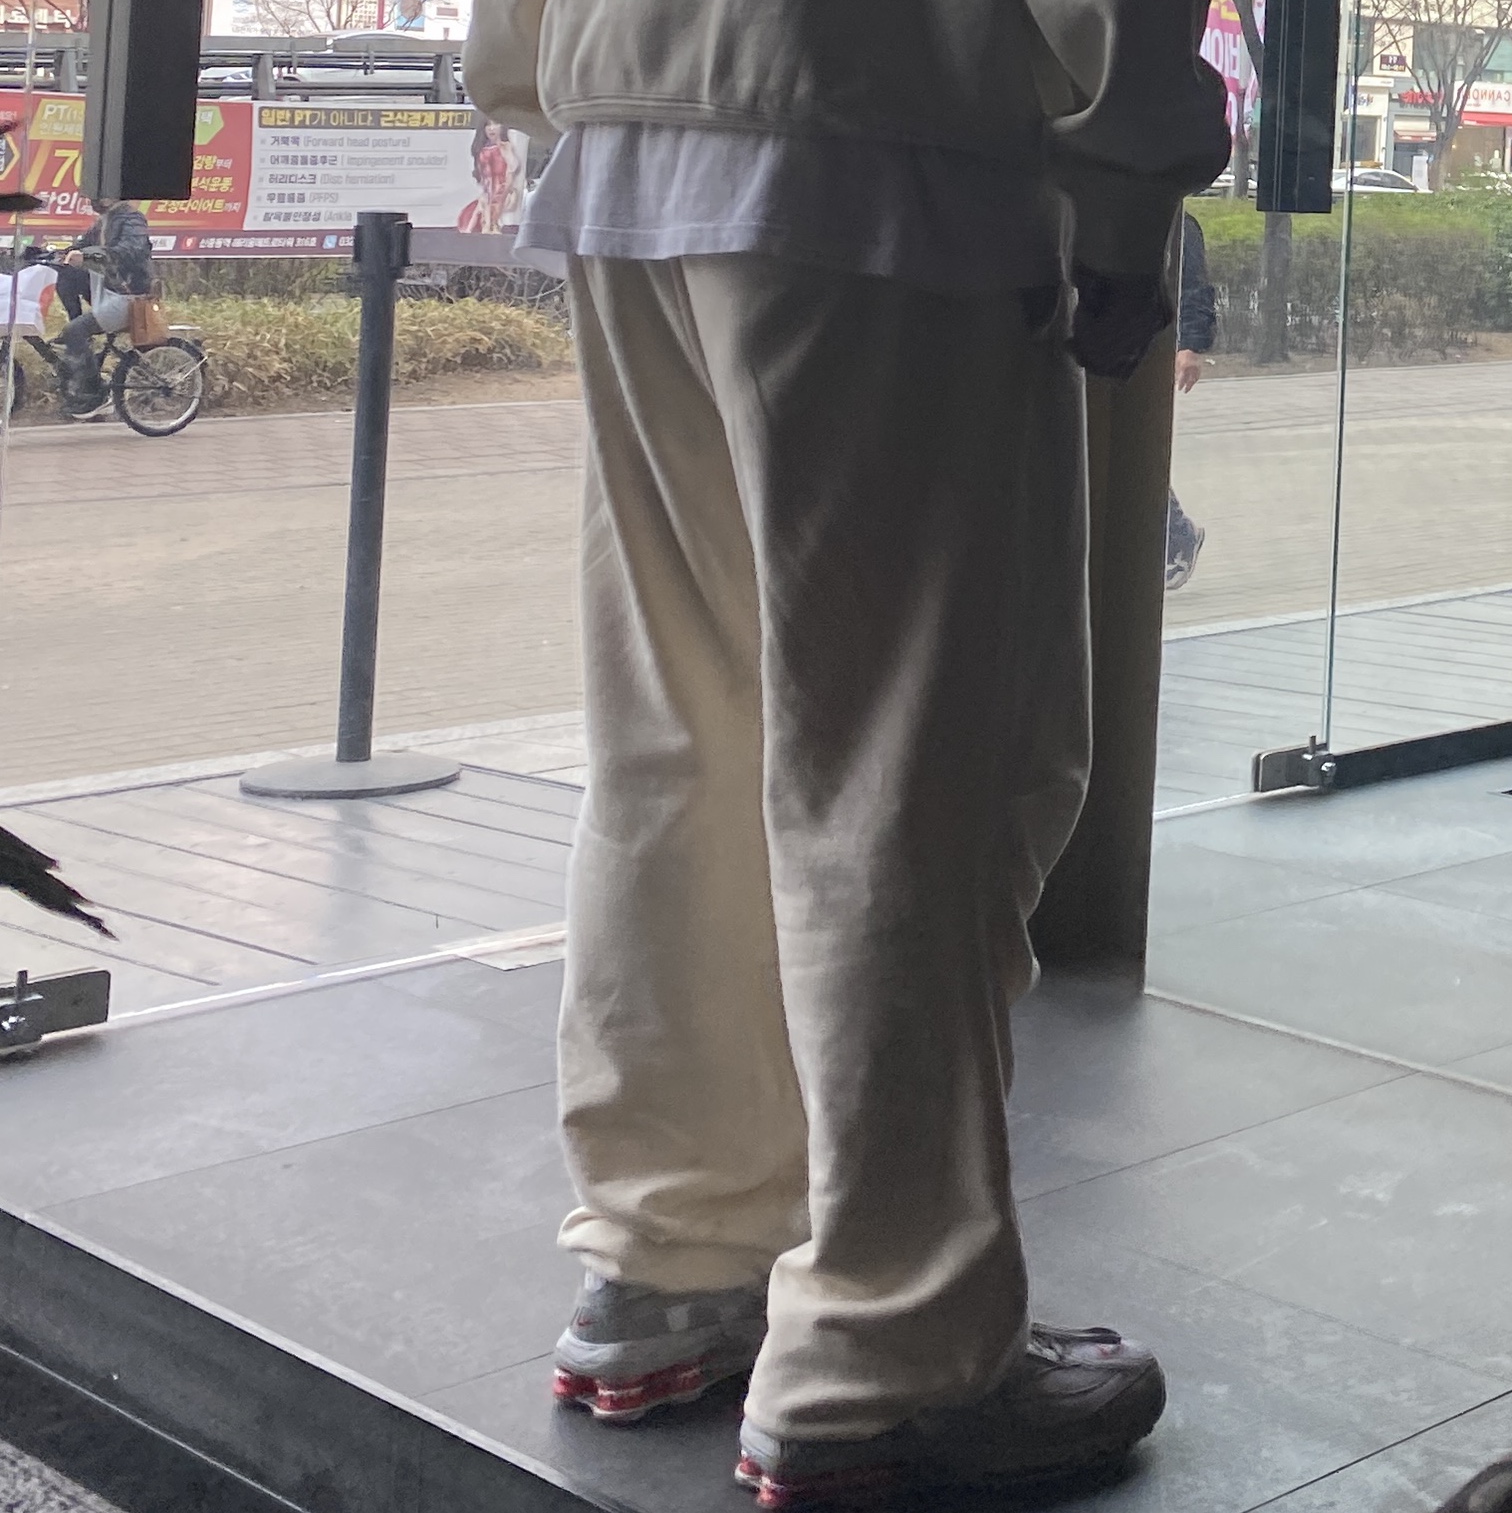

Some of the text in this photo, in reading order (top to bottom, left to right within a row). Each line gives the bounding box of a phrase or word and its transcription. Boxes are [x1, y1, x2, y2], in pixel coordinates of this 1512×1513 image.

[261, 109, 292, 126] 일반
[294, 109, 327, 126] PT가
[380, 110, 436, 127] 근신경계
[347, 136, 369, 147] head
[269, 173, 317, 185] 허리디스크
